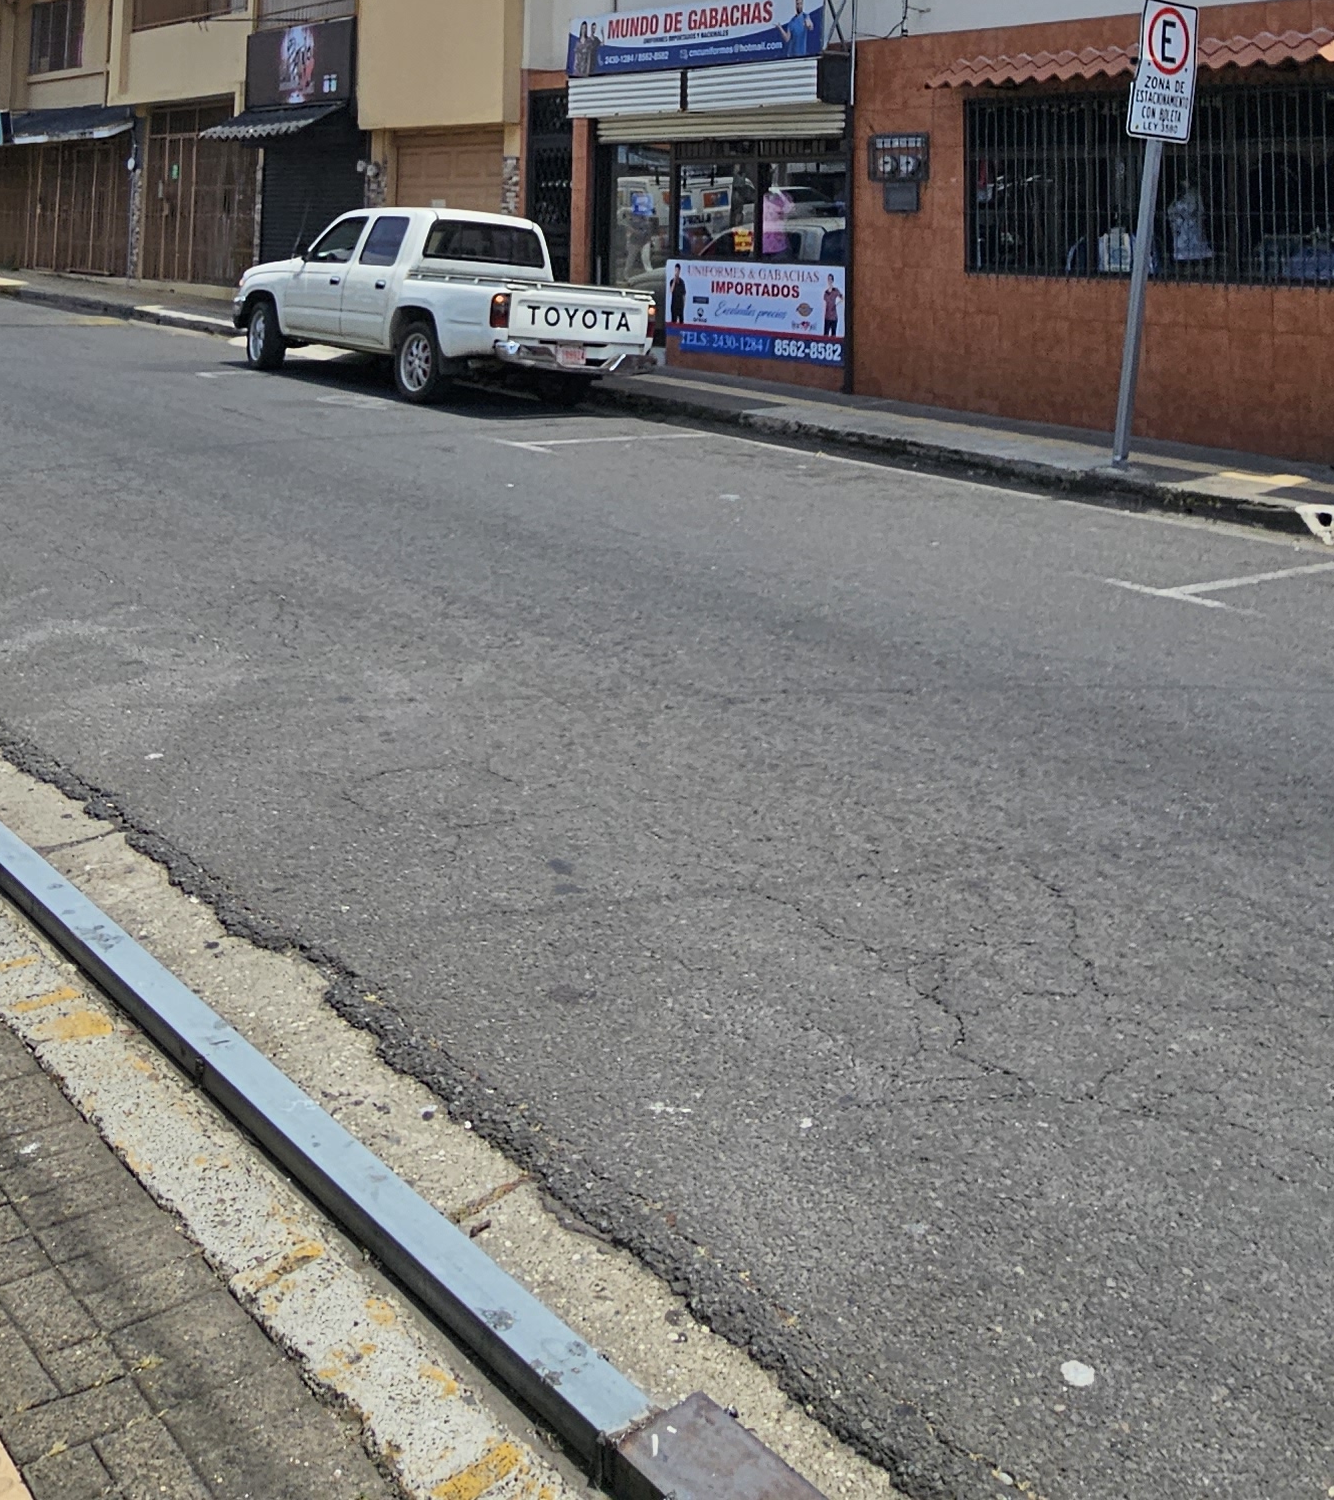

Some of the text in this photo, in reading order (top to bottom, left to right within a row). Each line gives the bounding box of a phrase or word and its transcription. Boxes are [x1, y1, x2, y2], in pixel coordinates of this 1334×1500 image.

[607, 0, 773, 40] MUNDO DE GABACHAS
[1161, 19, 1176, 64] E
[1144, 75, 1185, 94] ZONA DE
[1135, 89, 1189, 110] ESTACIONAMIENTO
[1141, 105, 1181, 123] CON BOLETA
[1142, 121, 1159, 131] LEY
[687, 264, 820, 283] UNIFORMES & GABACHAS
[711, 280, 800, 299] IMPORTADOS
[527, 305, 631, 332] TOYOTA
[680, 331, 709, 346] TELS:
[712, 334, 764, 351] 2430-1284
[774, 339, 842, 361] 8562-8582
